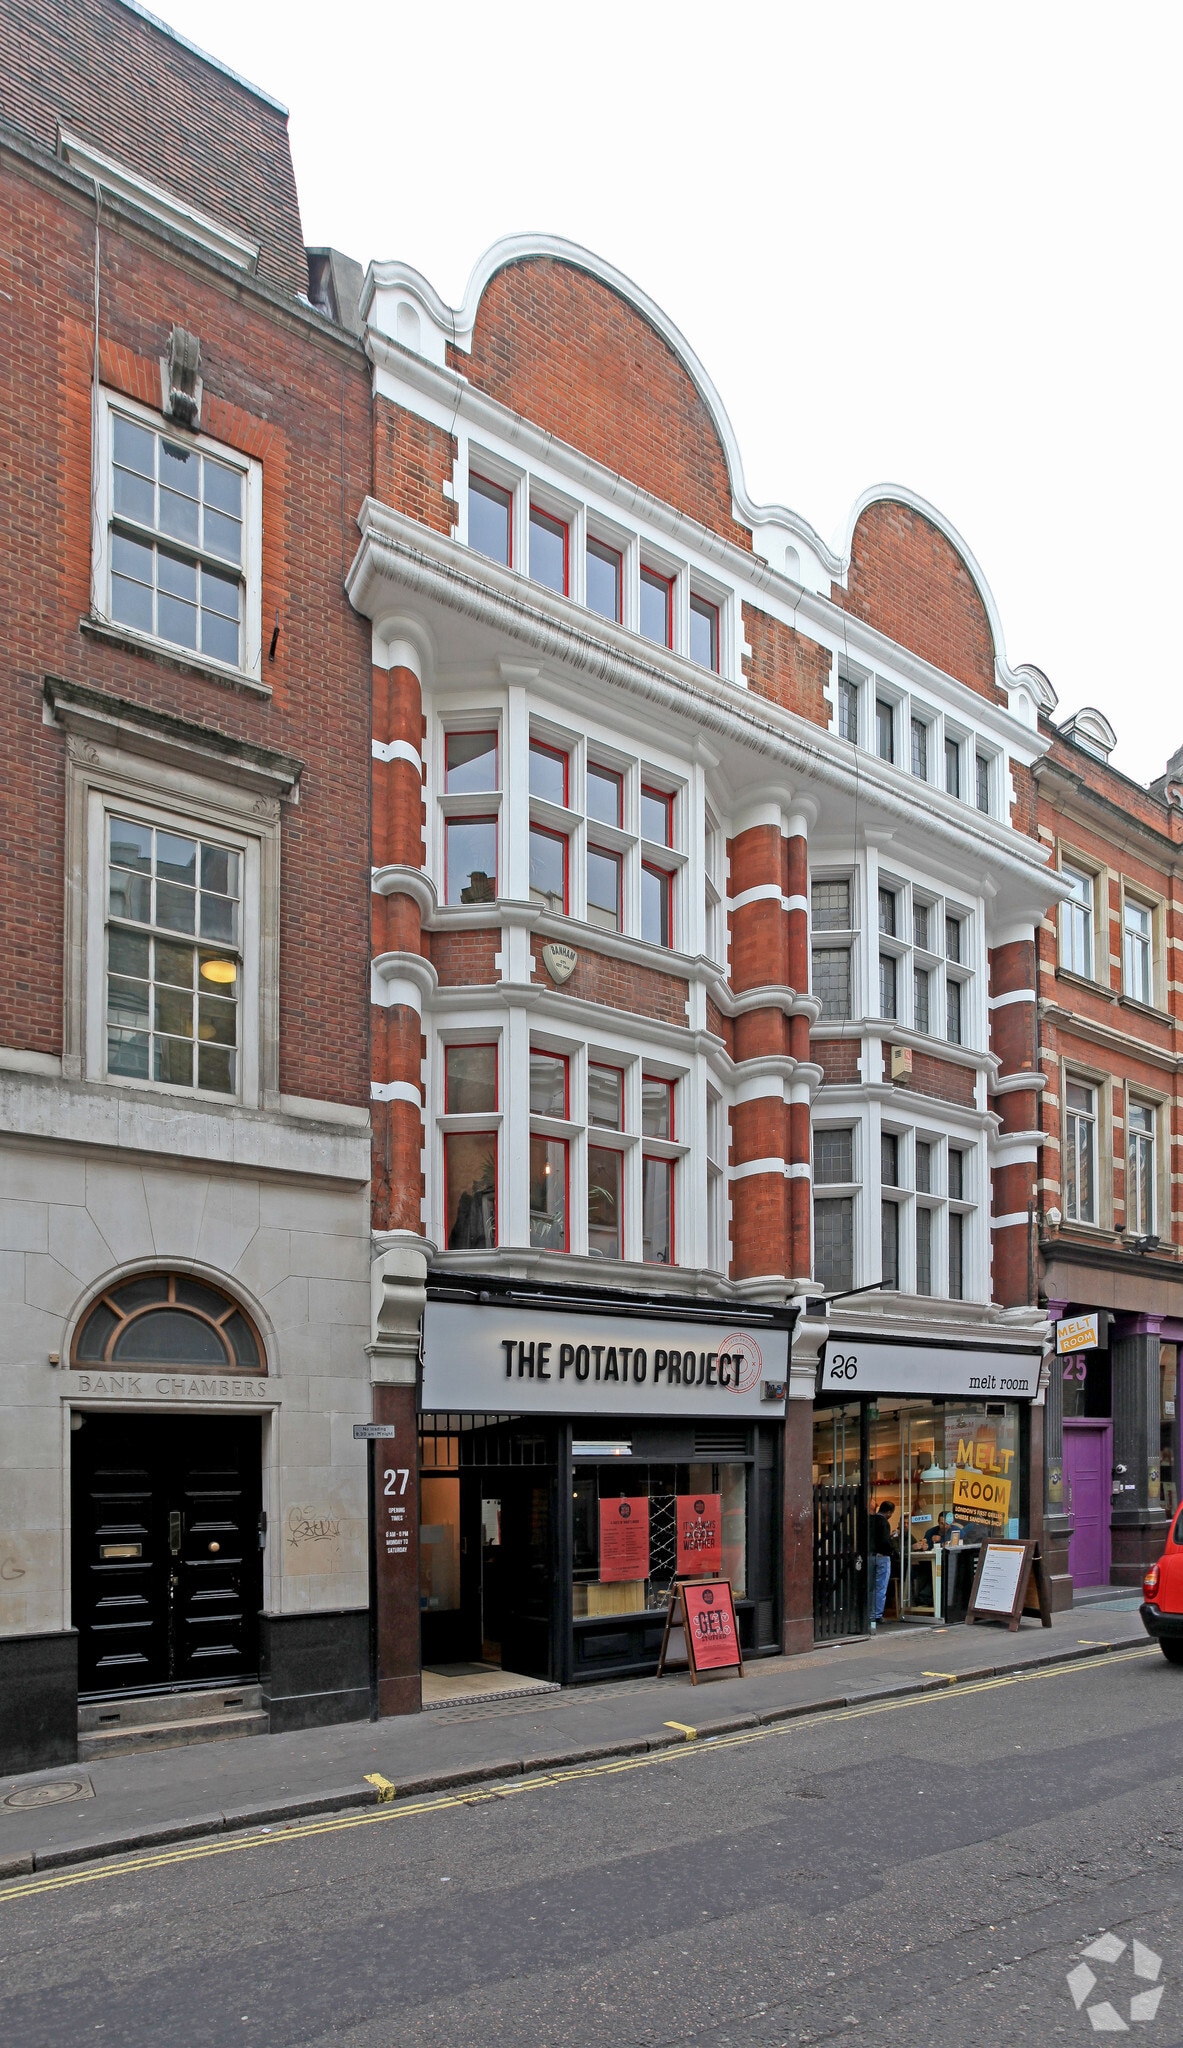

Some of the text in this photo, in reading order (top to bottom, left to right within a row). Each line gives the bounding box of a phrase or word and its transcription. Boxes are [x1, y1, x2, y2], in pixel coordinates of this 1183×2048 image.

[550, 945, 576, 961] BANHAM
[1057, 1316, 1091, 1338] MELT
[1063, 1332, 1092, 1348] ROOM
[501, 1340, 744, 1387] THE POTATO PROJECT
[830, 1354, 858, 1380] 26
[1063, 1354, 1087, 1380] 25
[78, 1375, 266, 1397] BANK CHAMBERS
[968, 1375, 1029, 1391] melt room
[956, 1438, 1015, 1475] MELT
[383, 1469, 410, 1496] 27
[959, 1481, 1006, 1505] ROOM
[954, 1506, 977, 1515] LONDON'S
[683, 1521, 693, 1531] IT'S
[683, 1538, 715, 1551] WEATHER
[698, 1610, 724, 1634] GET
